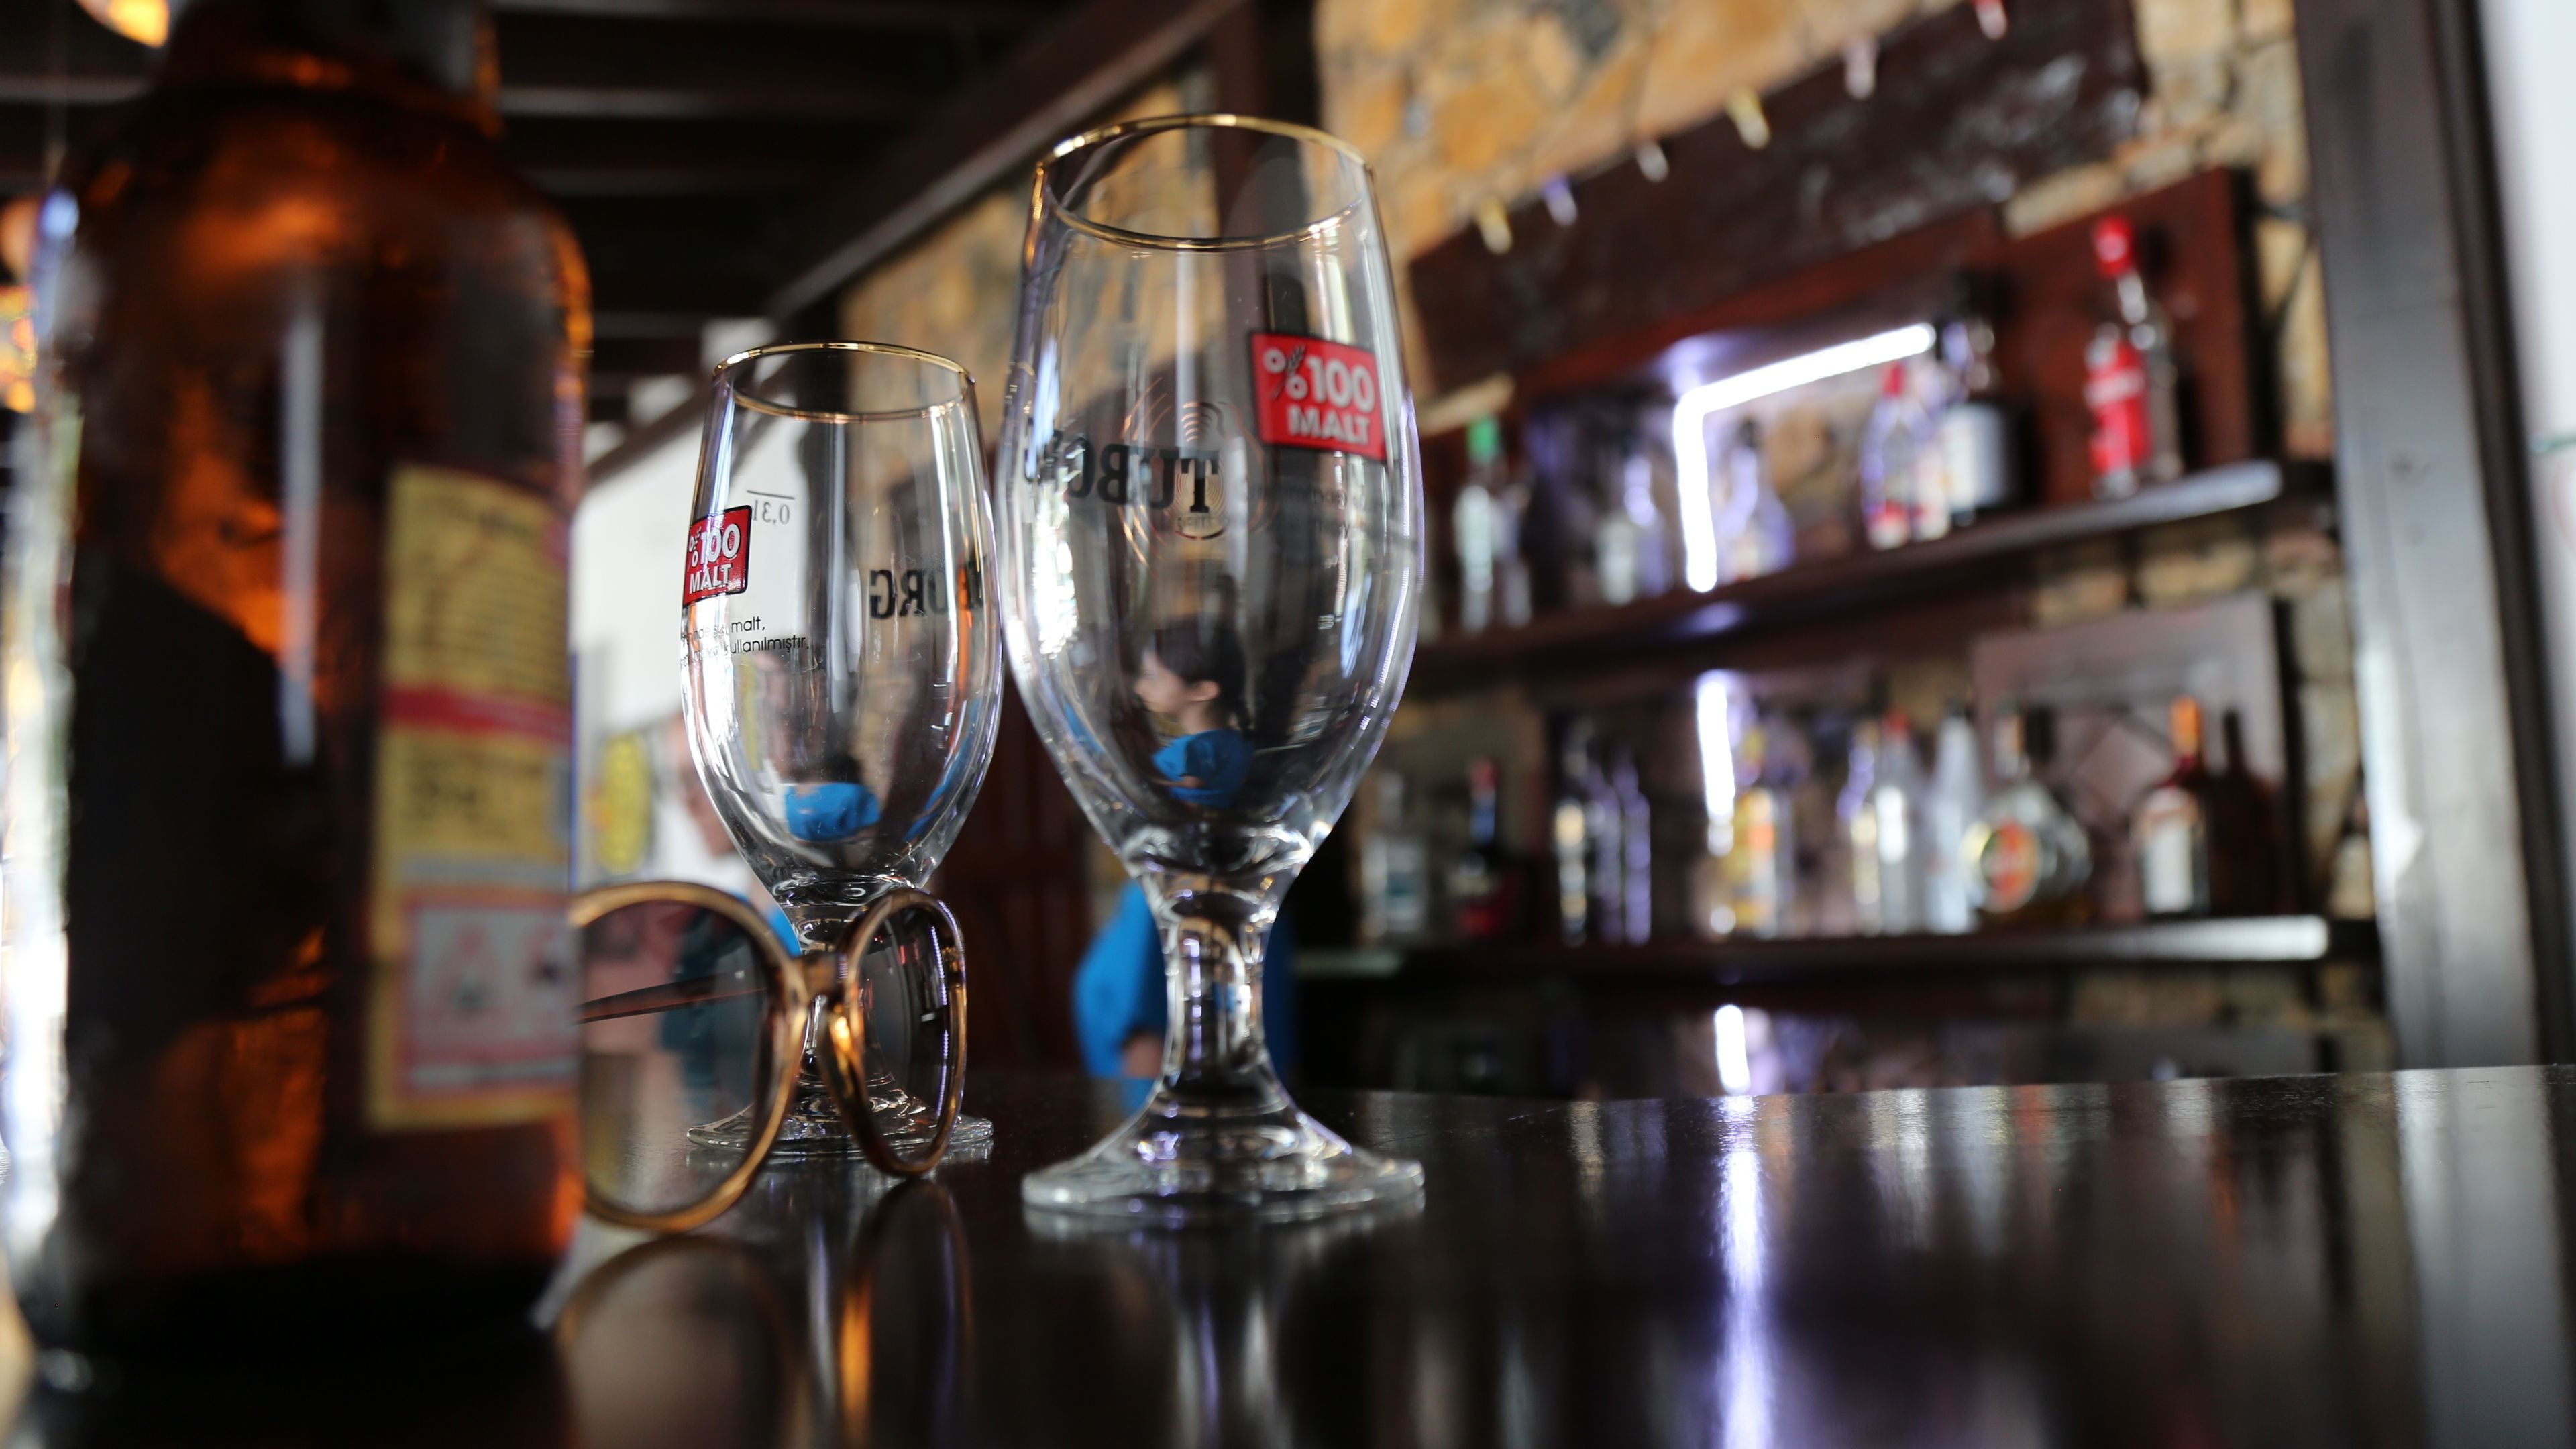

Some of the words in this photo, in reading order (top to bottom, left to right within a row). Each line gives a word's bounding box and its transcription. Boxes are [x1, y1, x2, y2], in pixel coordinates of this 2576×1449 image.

[1263, 343, 1375, 413] %100
[1287, 405, 1371, 447] MALT
[688, 524, 741, 568] %100
[689, 564, 732, 594] MALT
[731, 616, 766, 633] malt,
